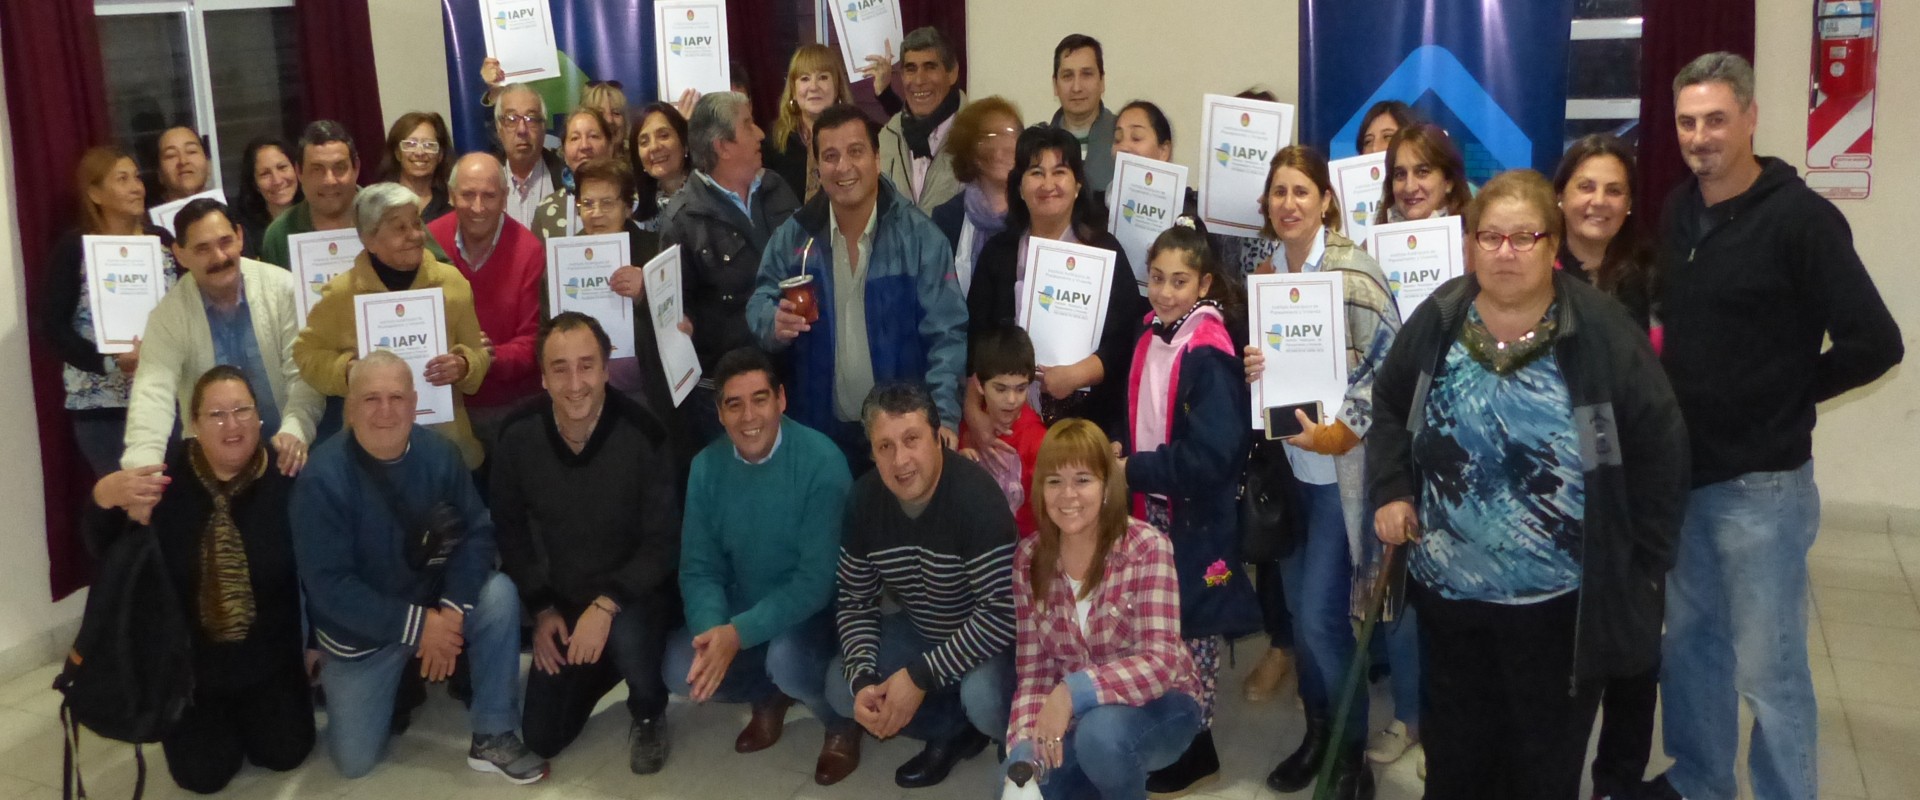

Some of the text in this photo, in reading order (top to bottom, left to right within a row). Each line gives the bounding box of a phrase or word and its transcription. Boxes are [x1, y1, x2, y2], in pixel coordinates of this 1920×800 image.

[508, 8, 535, 20] IAPV
[684, 36, 712, 46] IAPV
[1233, 146, 1268, 161] IAPV
[1137, 203, 1166, 219] IAPV
[118, 274, 148, 283] IAPV
[1403, 269, 1440, 283] IAPV
[1056, 289, 1091, 305] IAPV
[1285, 324, 1323, 337] IAPV
[393, 333, 427, 347] IAPV
